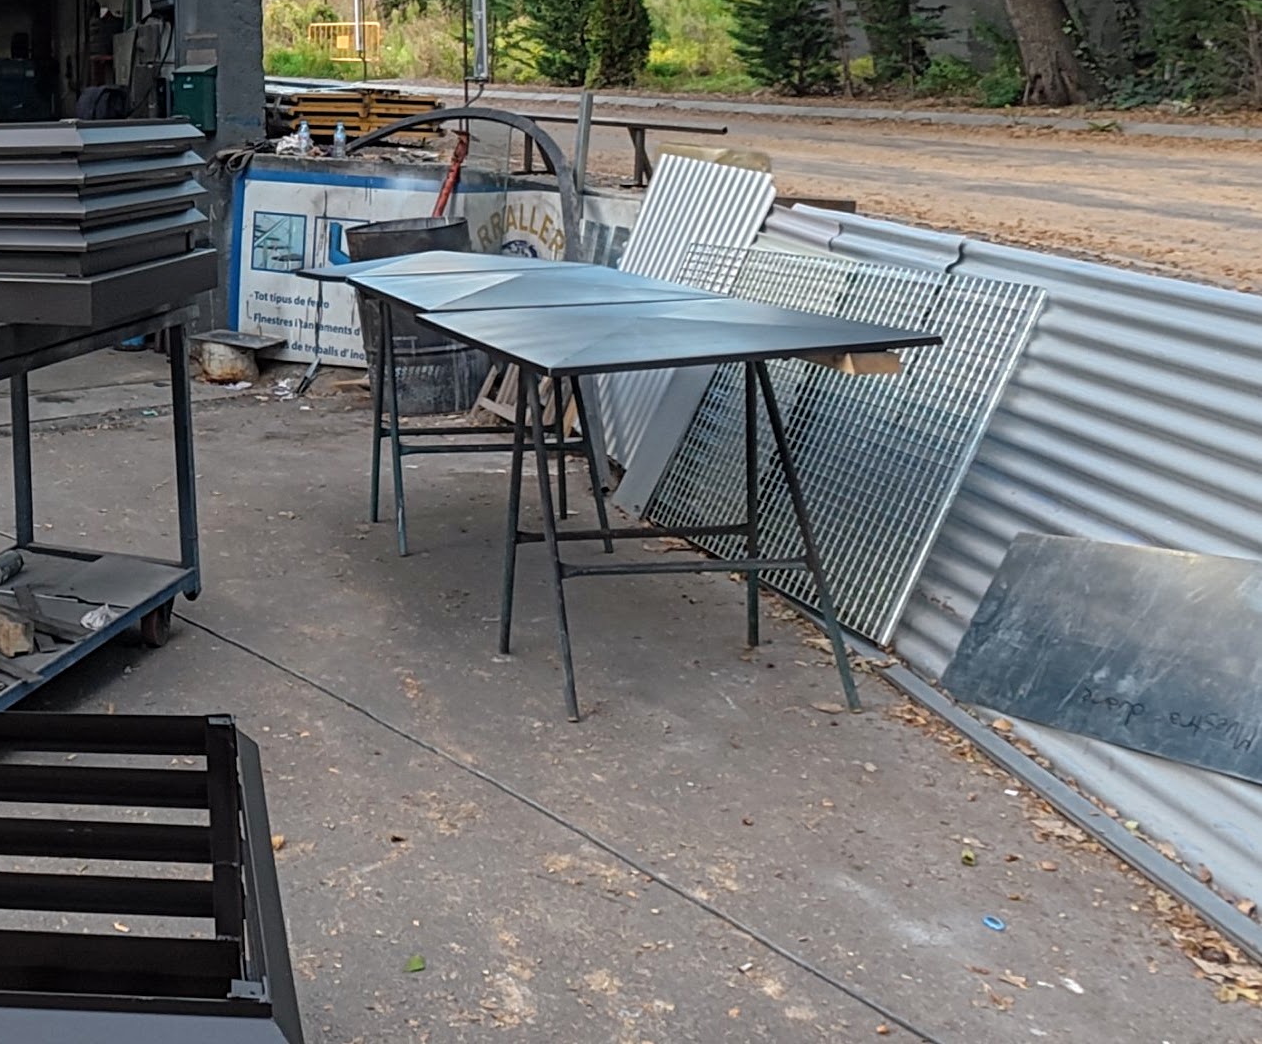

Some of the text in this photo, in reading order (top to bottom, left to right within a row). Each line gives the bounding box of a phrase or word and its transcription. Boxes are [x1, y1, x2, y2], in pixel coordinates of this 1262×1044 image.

[476, 203, 566, 260] RRALLER
[253, 291, 268, 302] Tot
[294, 295, 305, 305] de
[253, 313, 293, 328] Finestres
[299, 319, 352, 335] tanaments
[291, 341, 303, 352] de
